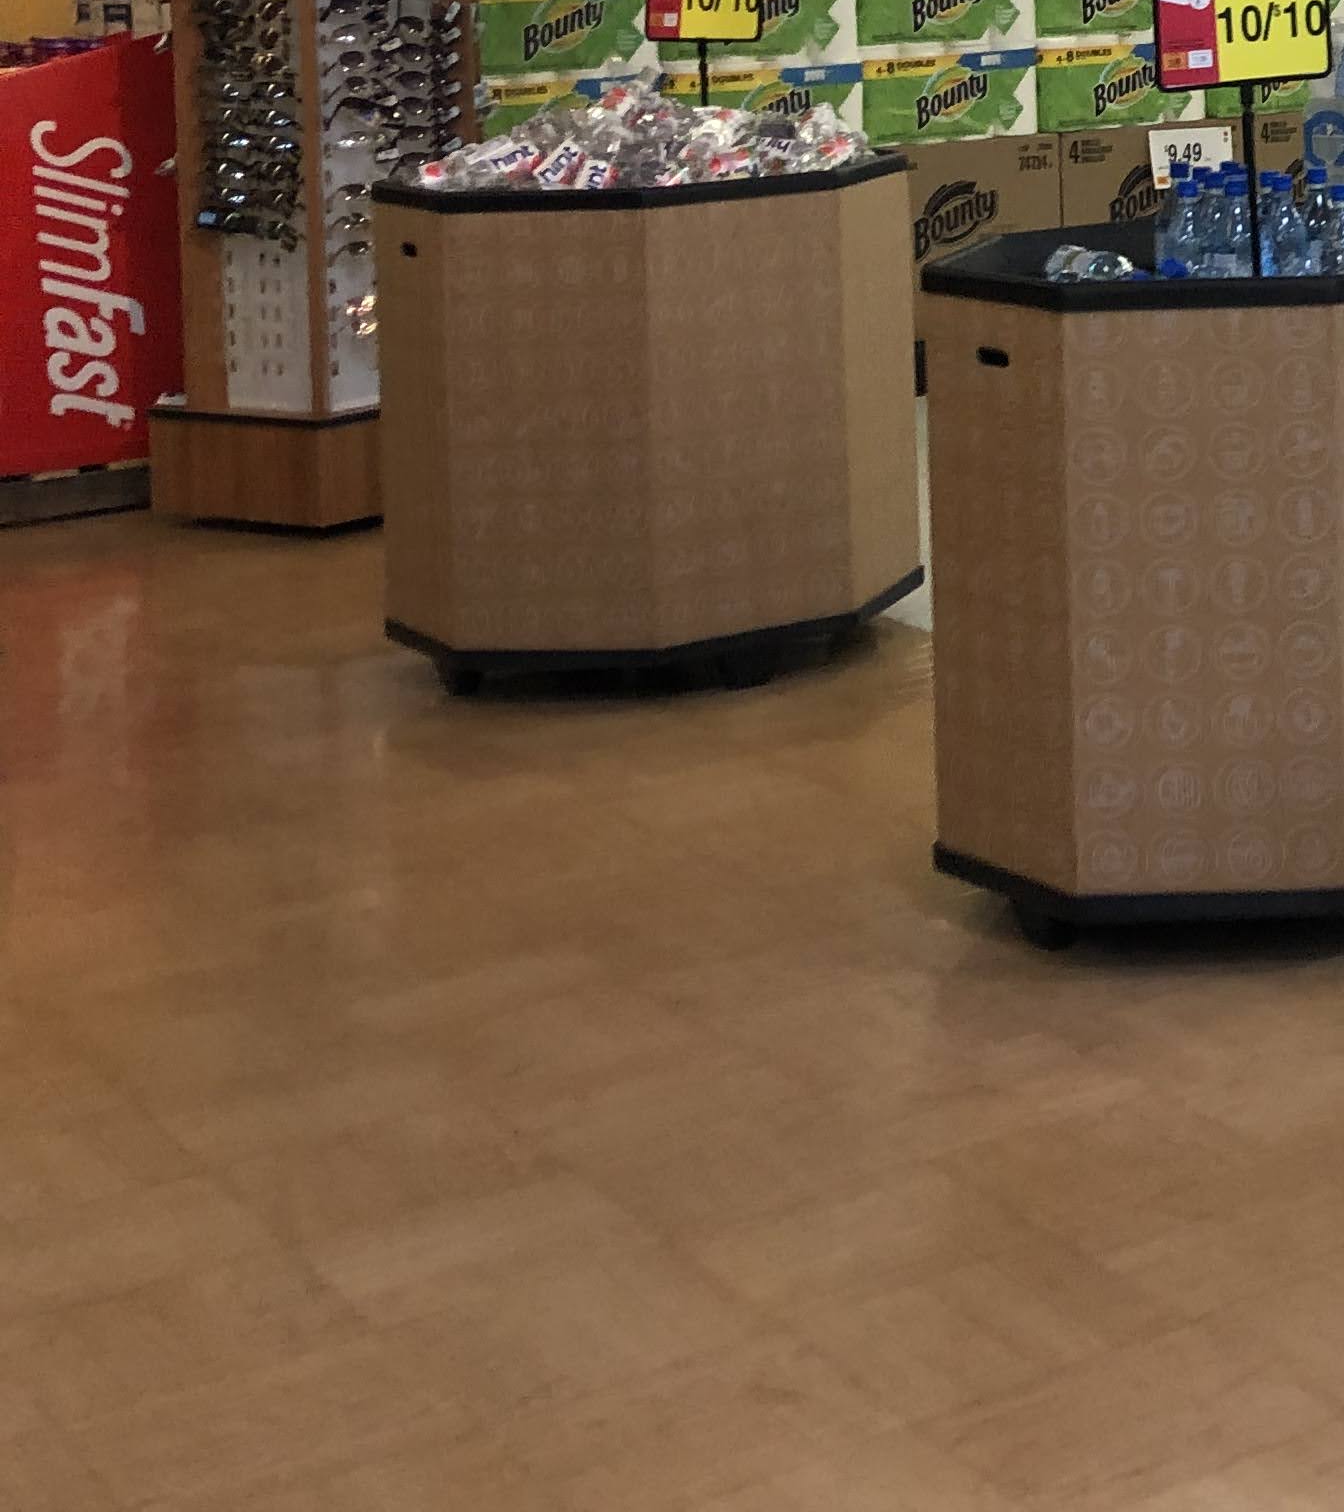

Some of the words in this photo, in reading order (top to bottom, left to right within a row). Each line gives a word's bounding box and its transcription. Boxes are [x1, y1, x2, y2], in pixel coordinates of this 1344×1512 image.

[523, 0, 604, 62] Bounty
[916, 72, 988, 131] Bounty
[912, 188, 998, 263] Bounty
[30, 120, 145, 428] SlimFast
